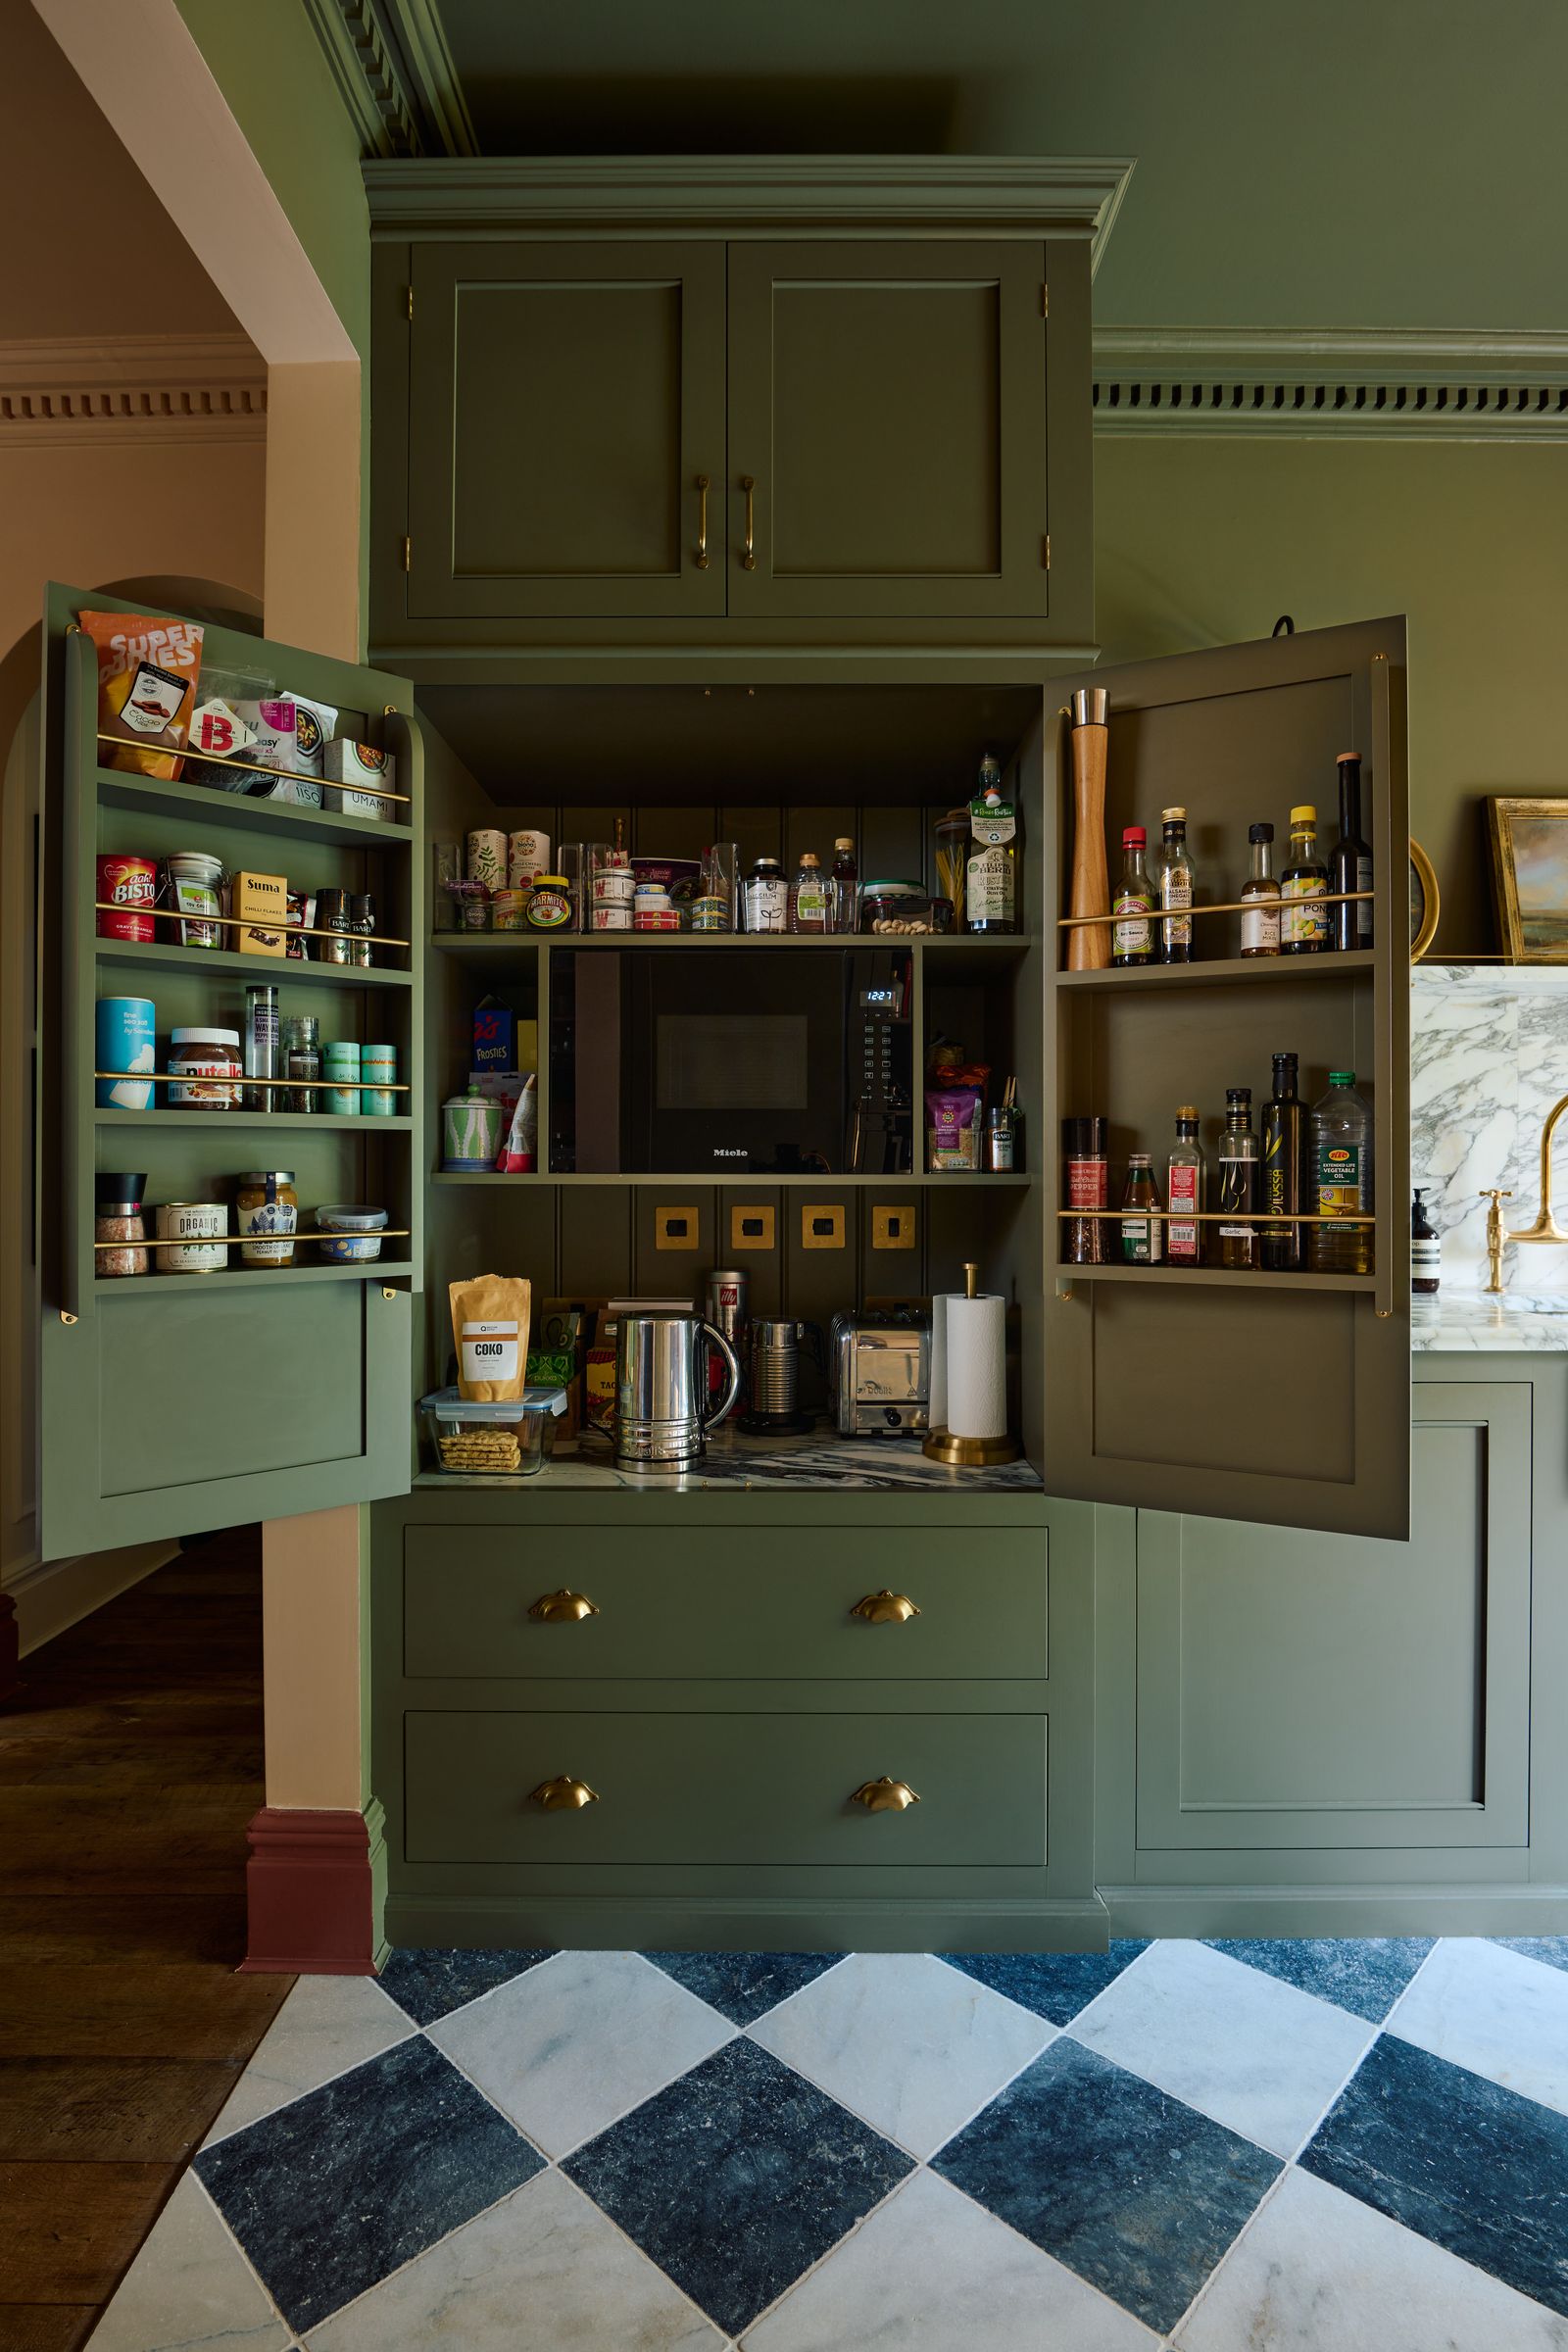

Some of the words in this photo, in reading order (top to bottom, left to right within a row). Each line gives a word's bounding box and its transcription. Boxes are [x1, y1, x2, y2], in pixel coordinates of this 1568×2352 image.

[110, 623, 204, 658] SUPER
[129, 709, 161, 726] Cacao
[352, 792, 388, 813] UMAMI
[115, 882, 155, 905] BISTO
[247, 878, 280, 894] Suma
[531, 896, 564, 907] MARMITE
[867, 991, 892, 1001] 12:27
[476, 1045, 507, 1061] FROSTIES
[712, 1149, 749, 1157] Miele
[179, 1217, 218, 1234] ORGANIC
[720, 1291, 737, 1304] illy
[474, 1343, 503, 1356] COKO
